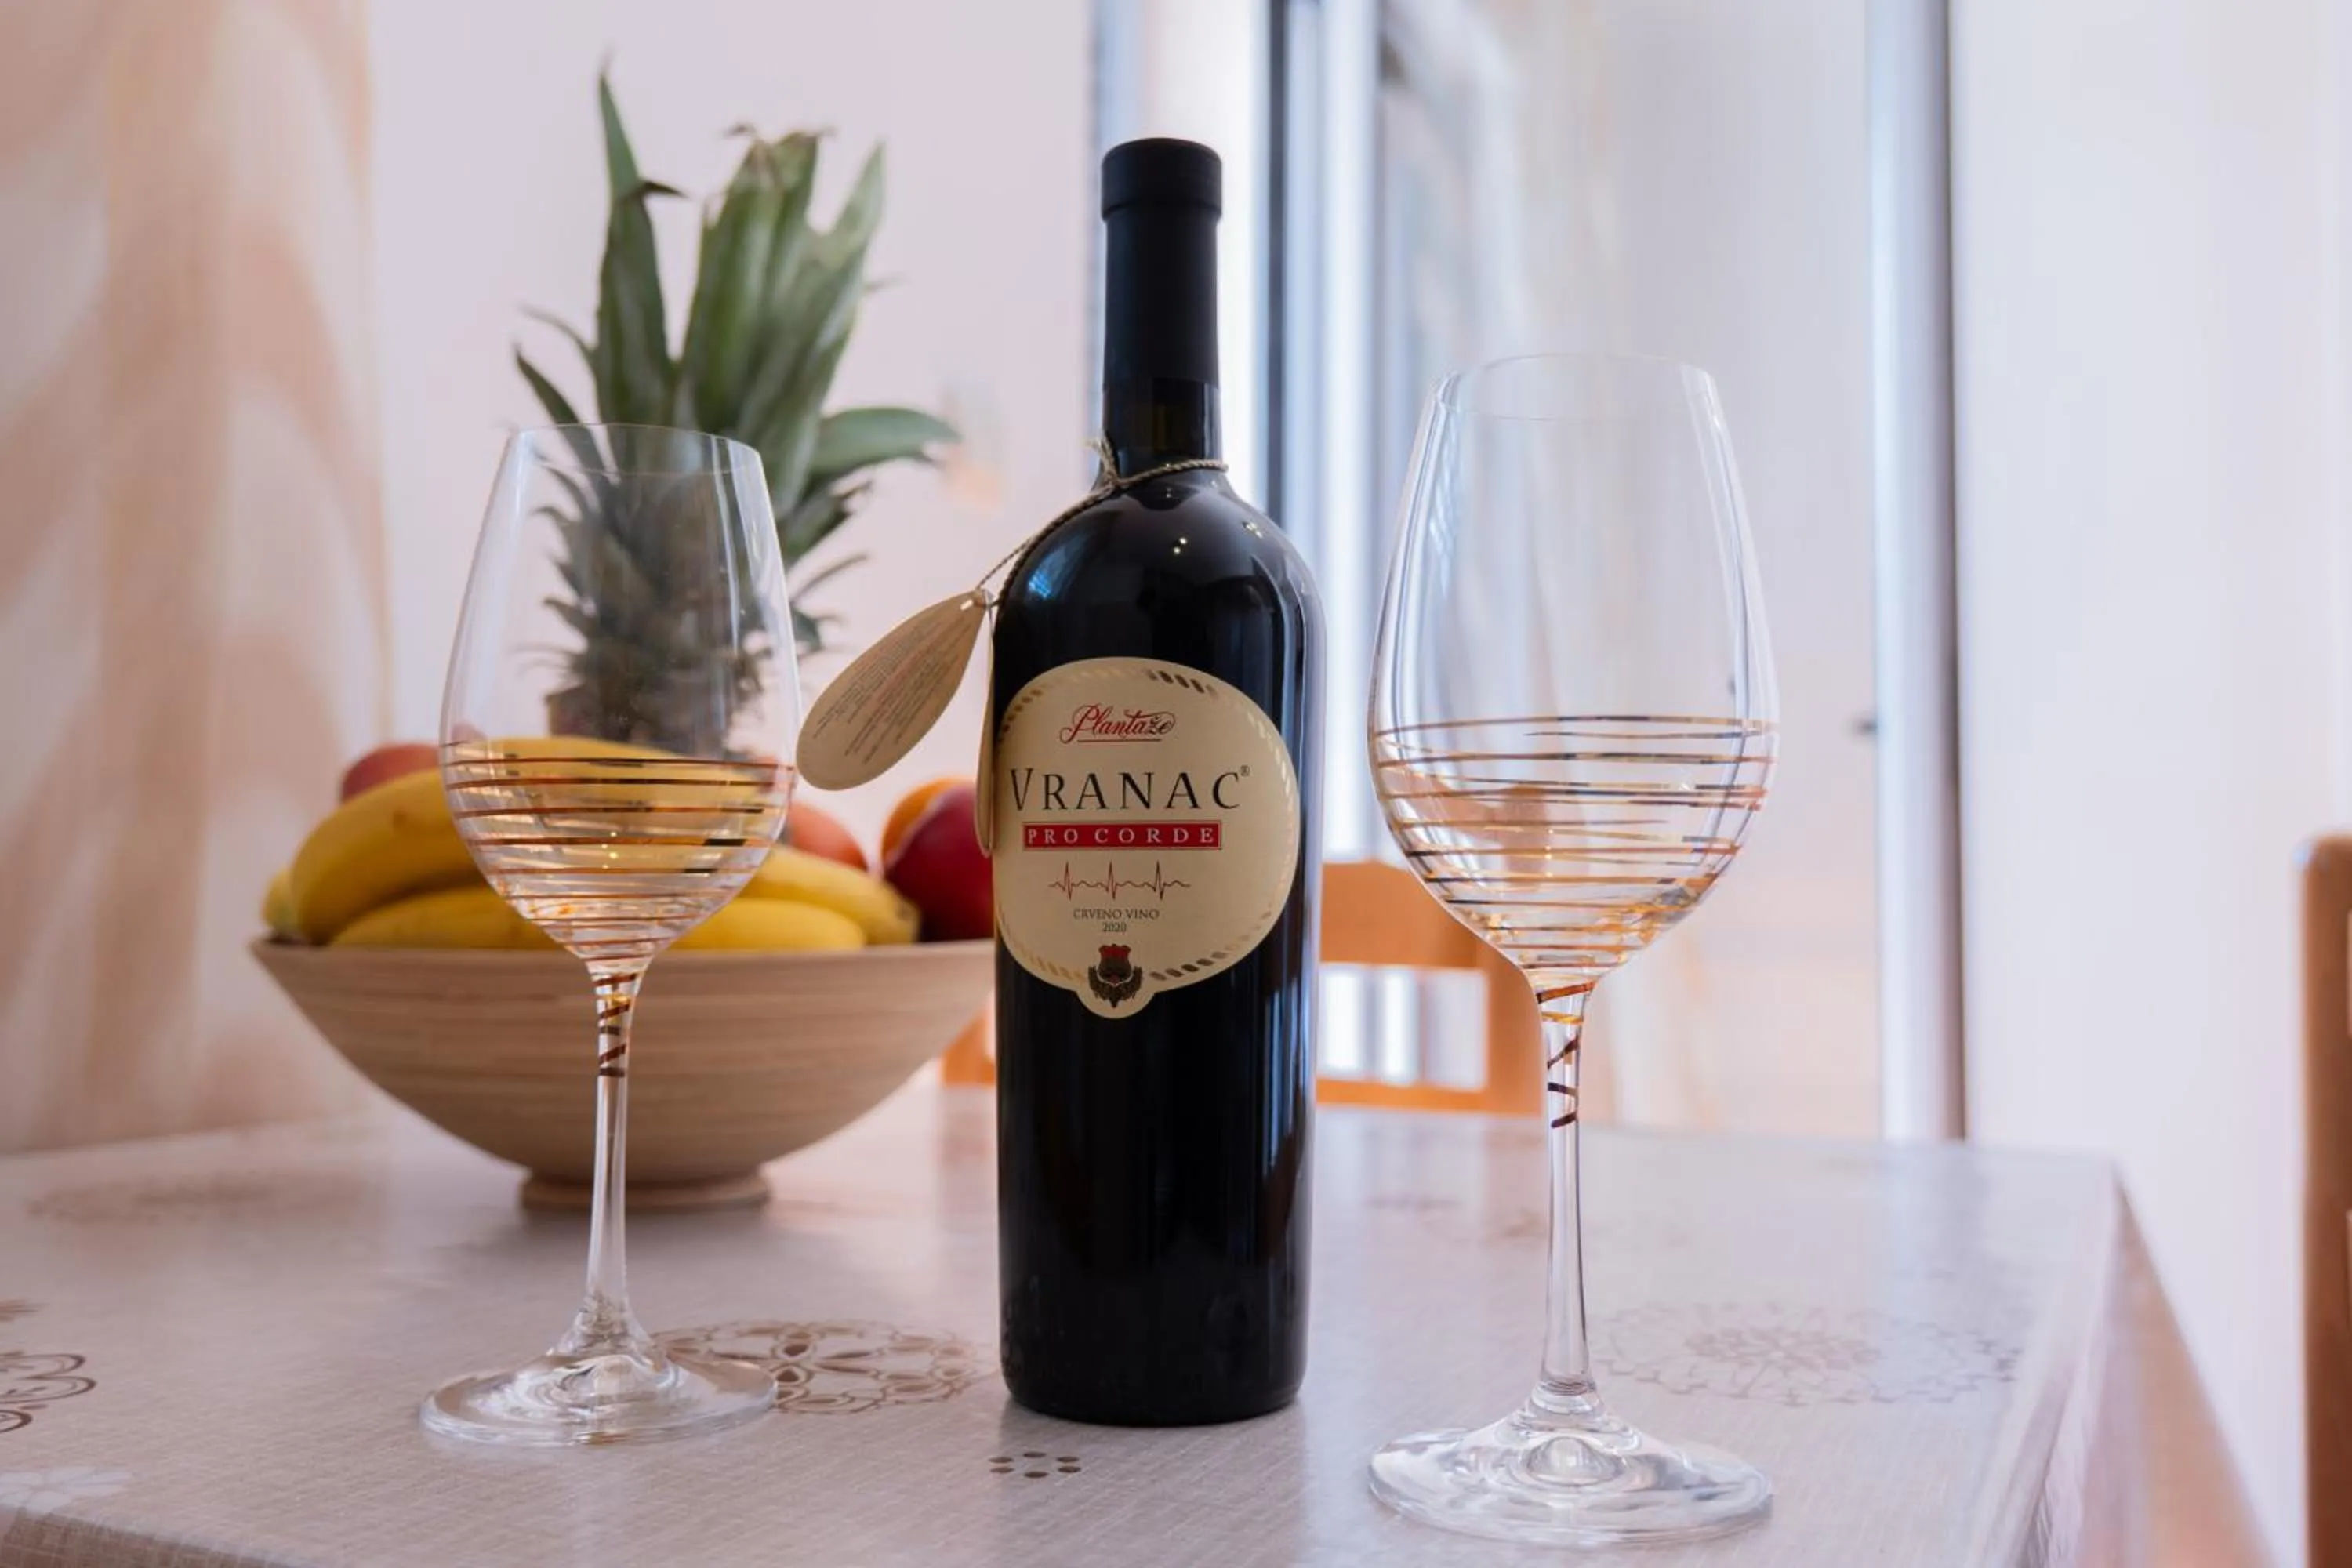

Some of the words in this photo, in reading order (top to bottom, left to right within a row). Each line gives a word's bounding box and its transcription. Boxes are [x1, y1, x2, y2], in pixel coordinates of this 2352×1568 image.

[1059, 703, 1176, 743] Plantaže
[1027, 828, 1079, 844] PRO
[1094, 827, 1215, 844] CORDE
[1073, 909, 1122, 920] CRVENO
[1125, 909, 1160, 920] VINO
[1102, 922, 1127, 932] 2020
